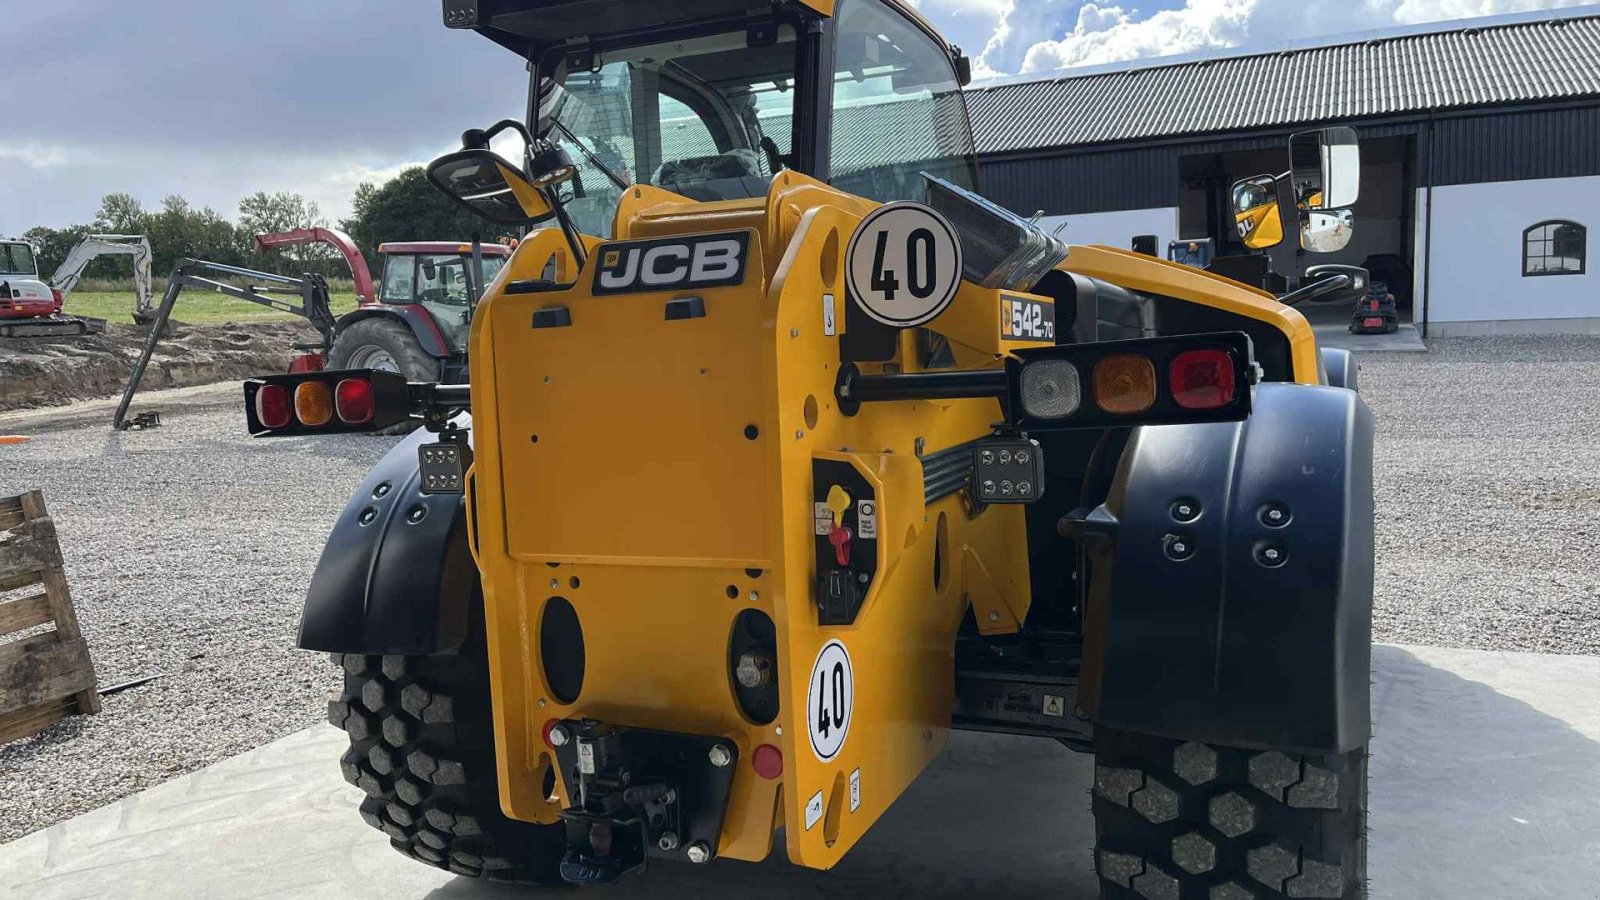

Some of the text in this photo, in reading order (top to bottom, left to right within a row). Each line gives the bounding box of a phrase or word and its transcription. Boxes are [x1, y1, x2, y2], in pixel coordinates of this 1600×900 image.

[600, 240, 740, 288] JCB
[871, 228, 936, 300] 40
[818, 661, 845, 739] 40
